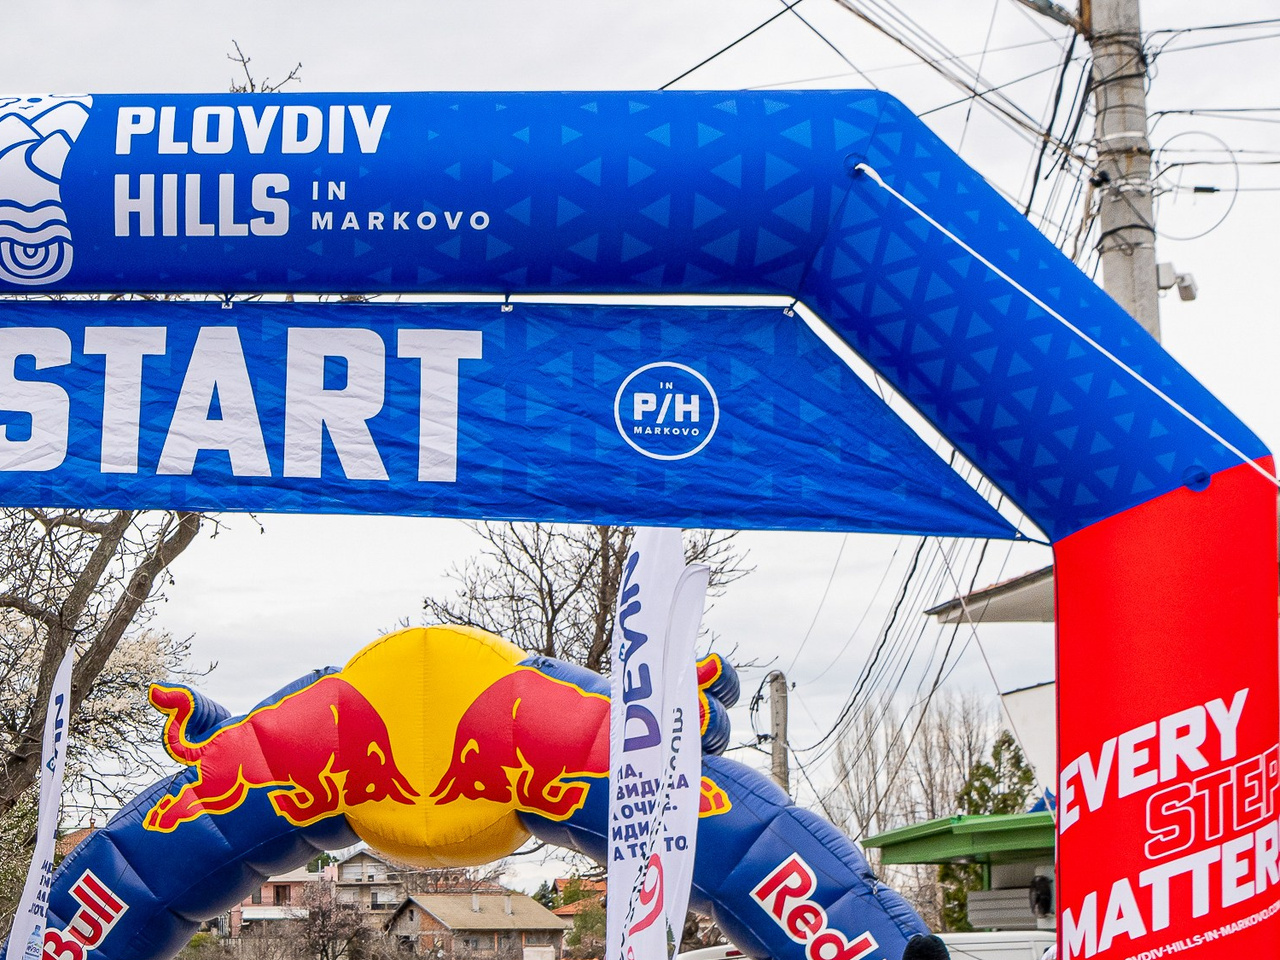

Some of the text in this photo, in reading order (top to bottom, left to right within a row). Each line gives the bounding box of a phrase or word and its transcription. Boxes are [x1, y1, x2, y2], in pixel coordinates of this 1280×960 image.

[115, 105, 391, 154] PLOVDIV
[115, 173, 290, 237] HILLS
[311, 181, 346, 201] IN
[311, 211, 490, 231] MARKOVO
[659, 381, 673, 390] IN
[633, 392, 700, 424] P/H
[633, 426, 700, 436] MARKOVO
[1059, 687, 1250, 835] EVERY
[1144, 743, 1280, 860] STEP
